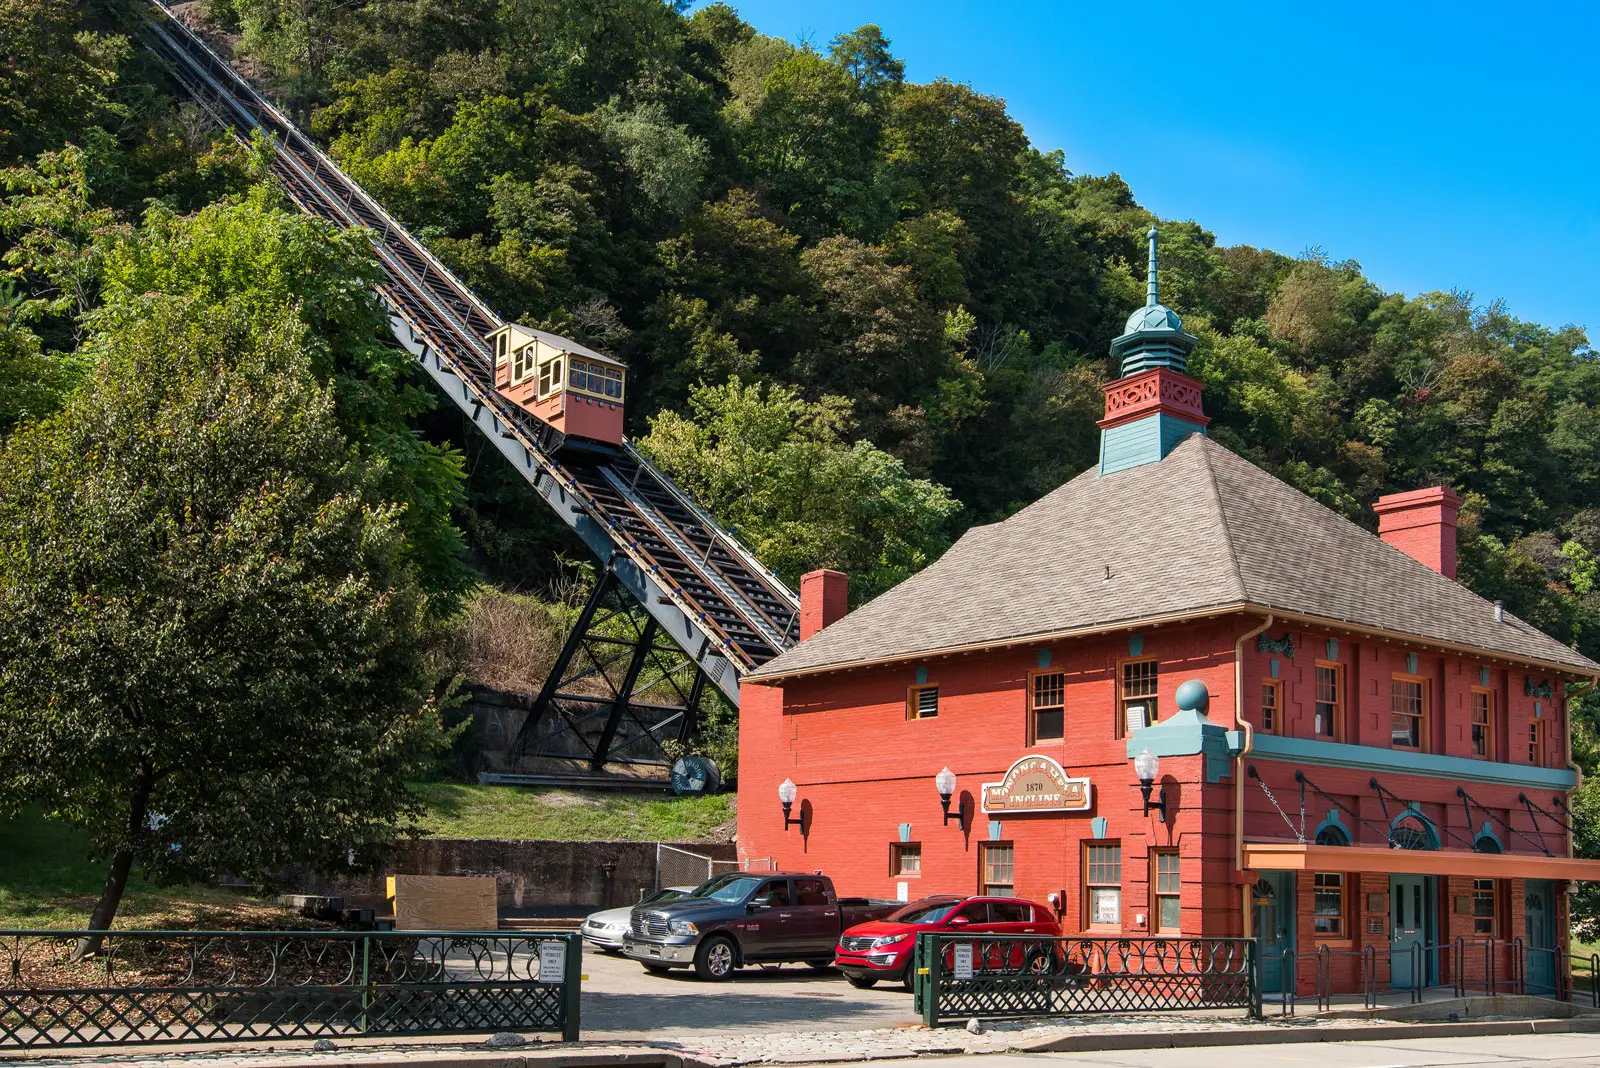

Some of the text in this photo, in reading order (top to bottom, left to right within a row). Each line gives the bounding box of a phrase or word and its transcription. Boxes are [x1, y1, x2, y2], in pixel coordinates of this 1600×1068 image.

[991, 761, 1079, 797] MONONGAHELA
[1025, 782, 1043, 792] 1870
[1009, 793, 1061, 803] INCLINE
